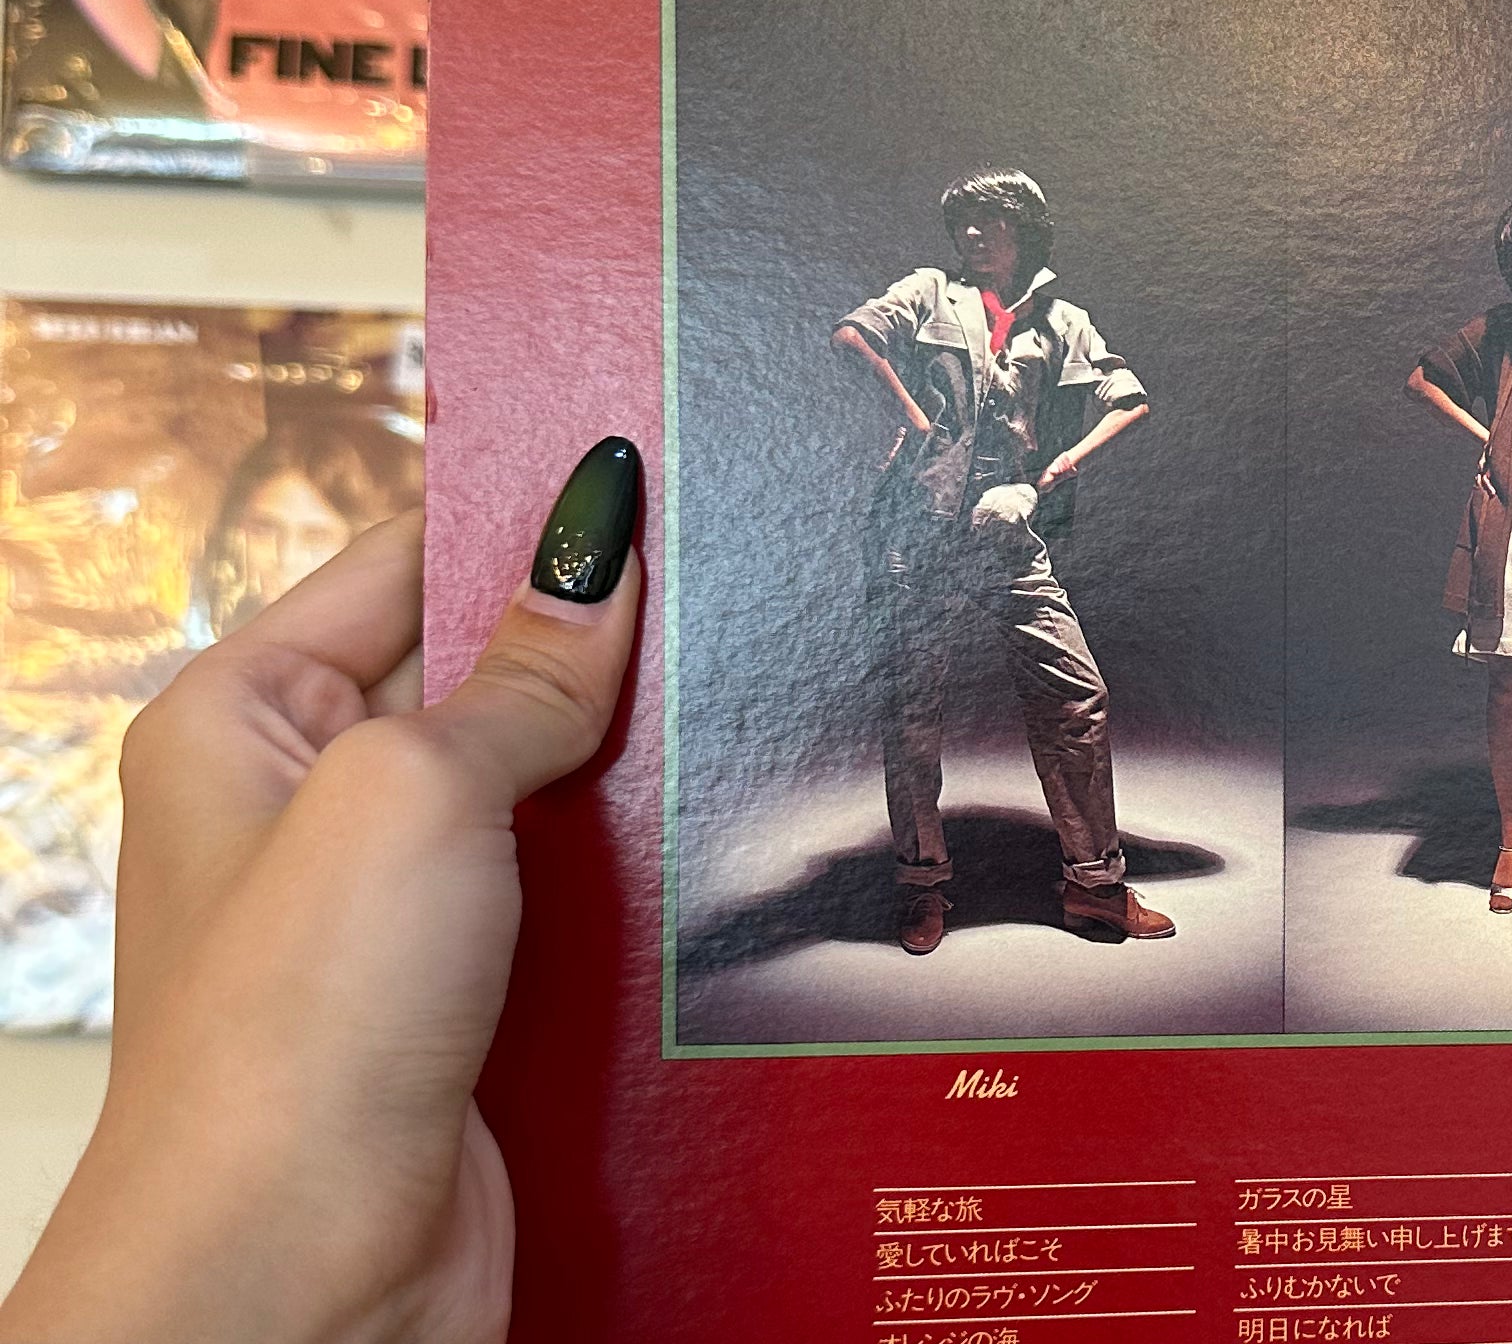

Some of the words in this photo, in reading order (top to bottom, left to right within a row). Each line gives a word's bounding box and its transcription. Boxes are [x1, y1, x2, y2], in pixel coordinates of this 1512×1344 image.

[229, 33, 393, 85] FINE
[944, 1068, 1020, 1100] Miki
[875, 1196, 984, 1225] 気軽な旅
[1237, 1183, 1354, 1211] ガラスの星
[875, 1237, 1064, 1271] 愛していればこそ
[875, 1279, 1099, 1313] ふたりのラヴ・ソング
[1239, 1272, 1402, 1301] ふりむかないで
[1237, 1313, 1394, 1344] 明日になれば
